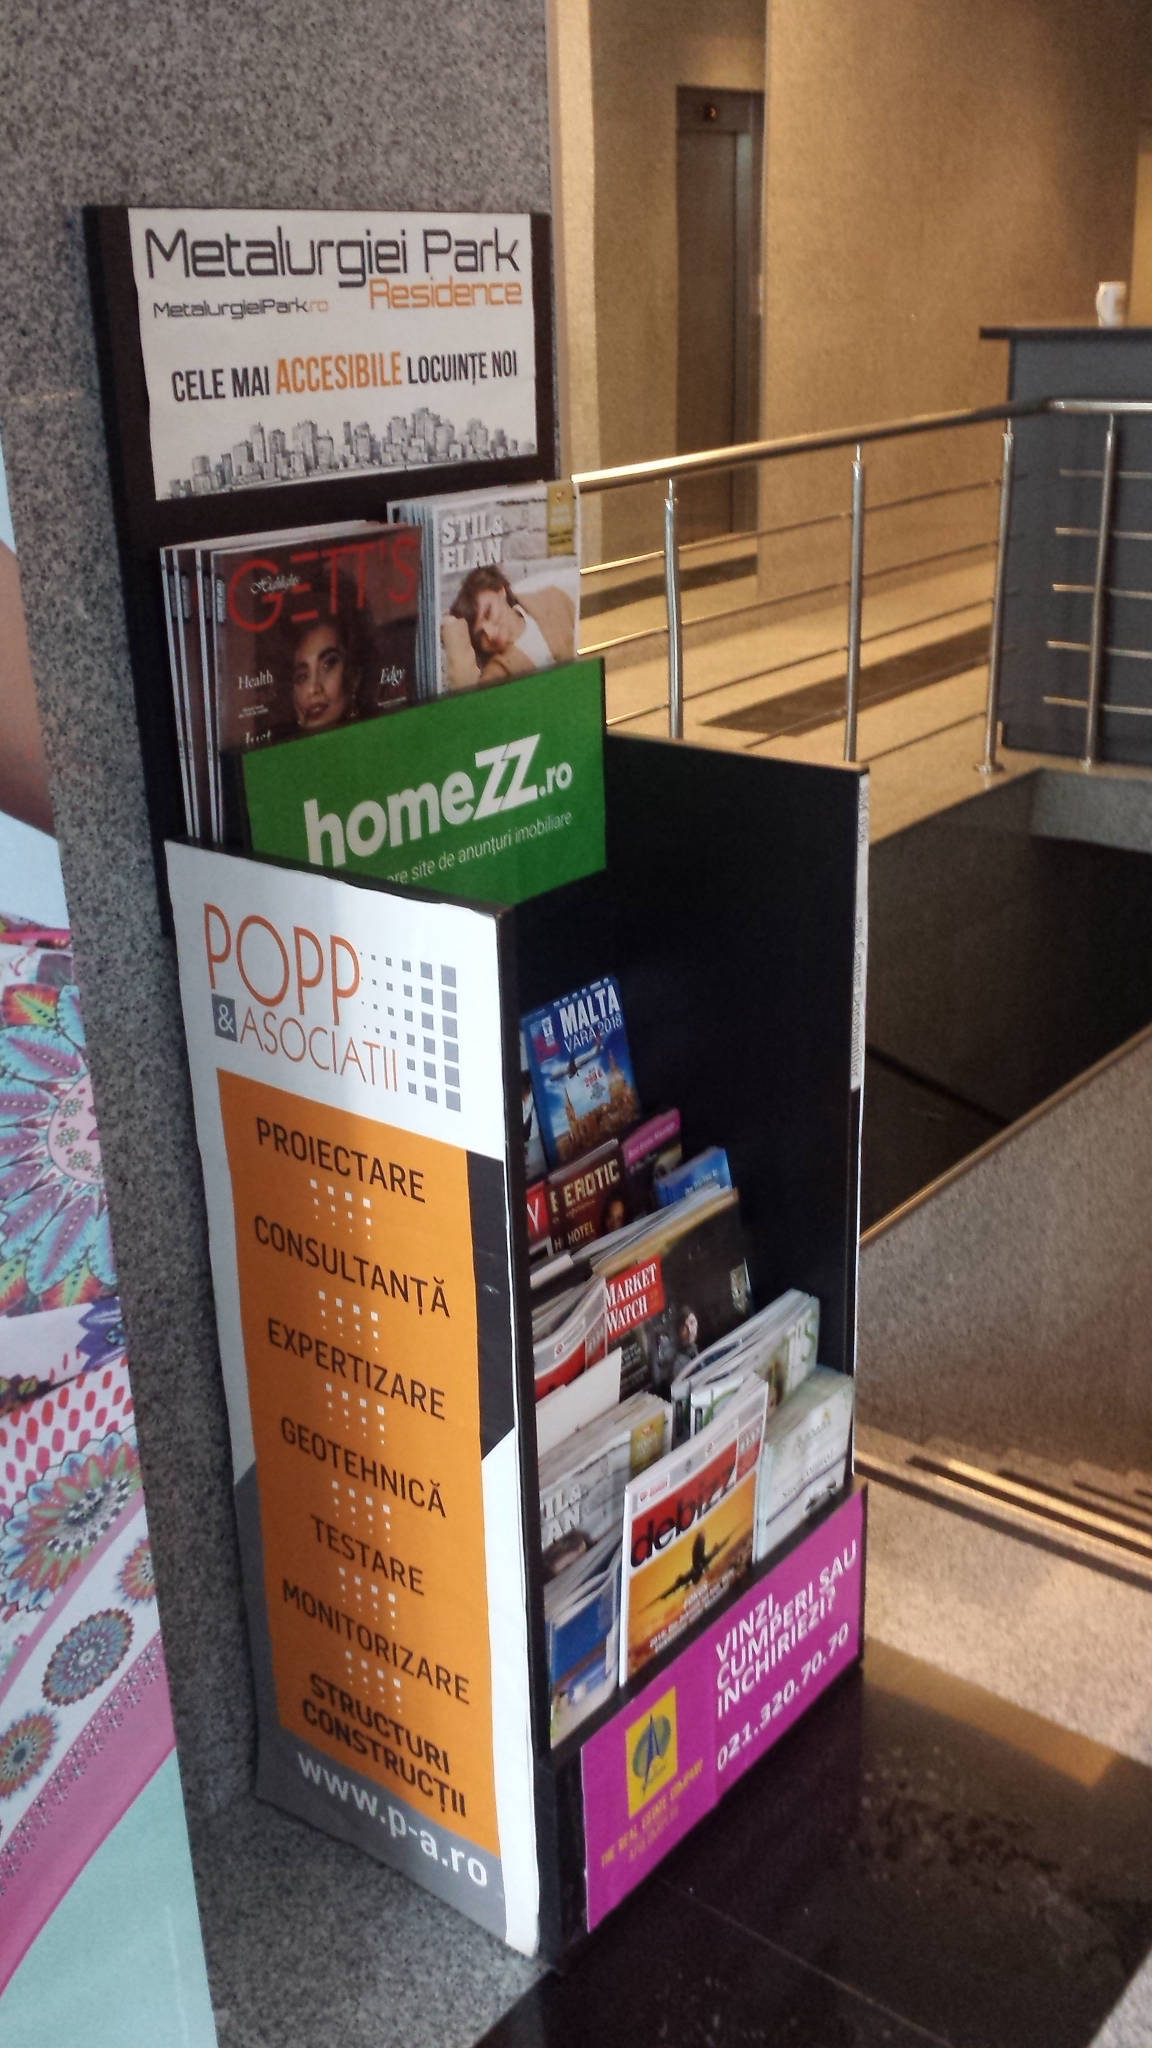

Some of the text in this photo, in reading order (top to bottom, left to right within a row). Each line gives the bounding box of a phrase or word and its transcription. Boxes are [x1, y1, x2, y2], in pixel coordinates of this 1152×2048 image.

[145, 226, 521, 288] Metalurgiei Park
[153, 297, 329, 320] MetalurgieiPark.ro
[369, 277, 522, 310] Residence
[172, 369, 226, 402] CELE
[232, 366, 271, 398] MAI
[276, 351, 402, 395] ACCESIBILE
[492, 350, 517, 379] NOI
[238, 669, 274, 690] Health
[410, 858, 437, 881] site
[438, 850, 456, 871] de
[514, 811, 574, 846] imobiliare
[204, 903, 360, 1026] POPP
[559, 984, 620, 1038] MALTA
[564, 1026, 596, 1055] VARA
[597, 1012, 623, 1036] 2018
[256, 1116, 426, 1203] PROIECTARE
[562, 1159, 621, 1206] EROTIC
[604, 1263, 657, 1309] MARKET
[606, 1294, 648, 1335] WATCH
[267, 1318, 446, 1420] EXPERTIZARE
[310, 1514, 425, 1595] TESTARE
[282, 1578, 470, 1704] MONITORIZARE
[717, 1582, 814, 1691] CUMPERI
[819, 1539, 858, 1590] SAU
[310, 1673, 450, 1775] STRUCTURI
[717, 1622, 850, 1773] 021.320.70.70
[297, 1751, 489, 1887] www.p-a.ro
